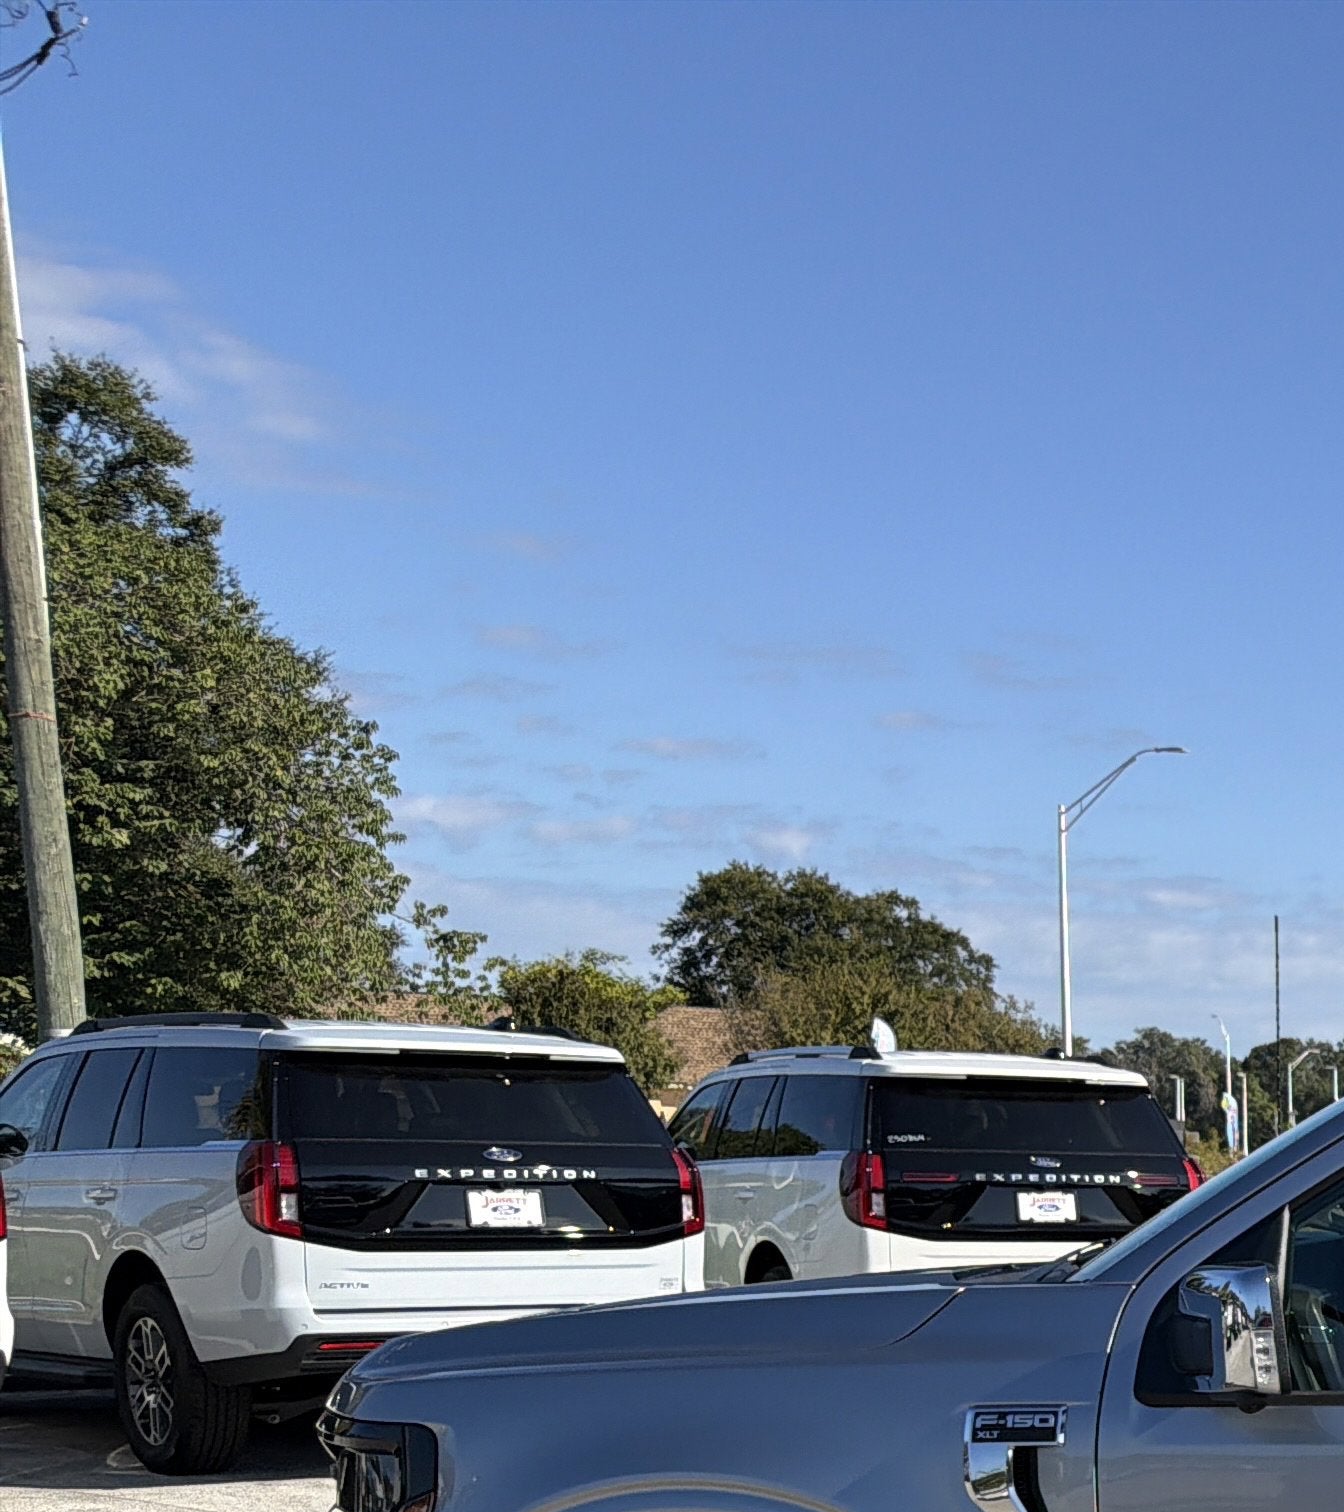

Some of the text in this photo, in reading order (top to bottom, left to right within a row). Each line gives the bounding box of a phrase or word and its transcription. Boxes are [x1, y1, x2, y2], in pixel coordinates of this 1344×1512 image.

[414, 1167, 596, 1180] EXPEDITION
[975, 1173, 1121, 1184] EXPEDITION
[319, 1282, 369, 1290] ACTIVE
[975, 1413, 1055, 1429] F-150
[976, 1430, 1000, 1439] XLT
